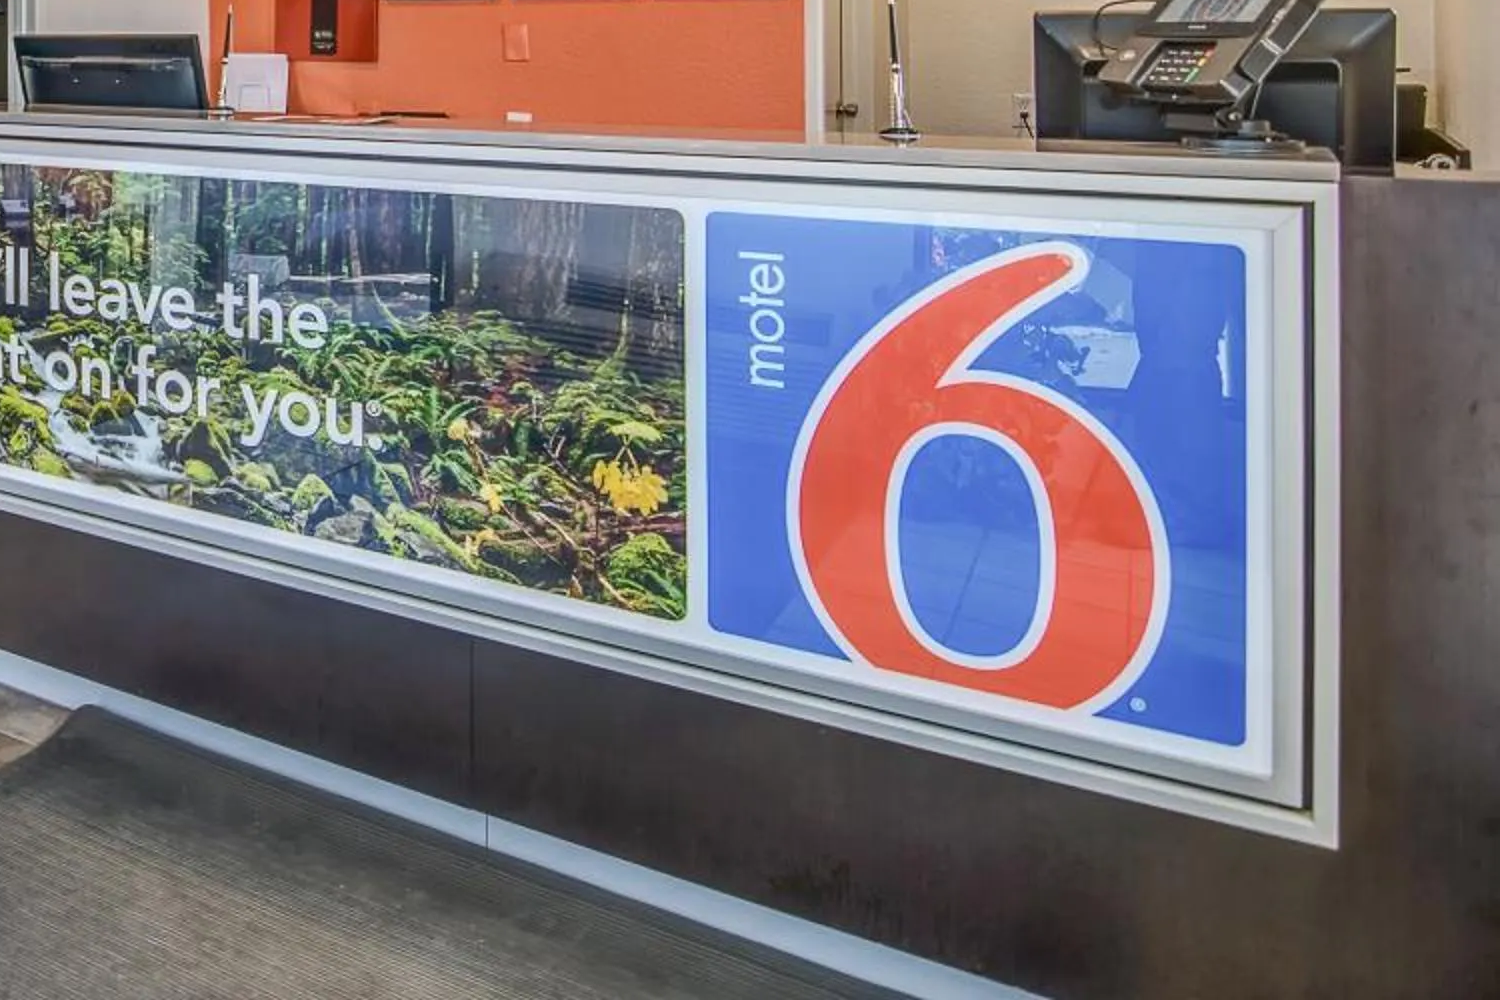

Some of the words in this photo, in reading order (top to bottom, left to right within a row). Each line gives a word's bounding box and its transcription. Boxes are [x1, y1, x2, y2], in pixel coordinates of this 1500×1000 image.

[49, 250, 195, 331] leave
[215, 273, 329, 350] the
[738, 250, 785, 390] motel
[43, 350, 111, 400] on
[132, 344, 221, 418] for
[785, 240, 1171, 717] 6
